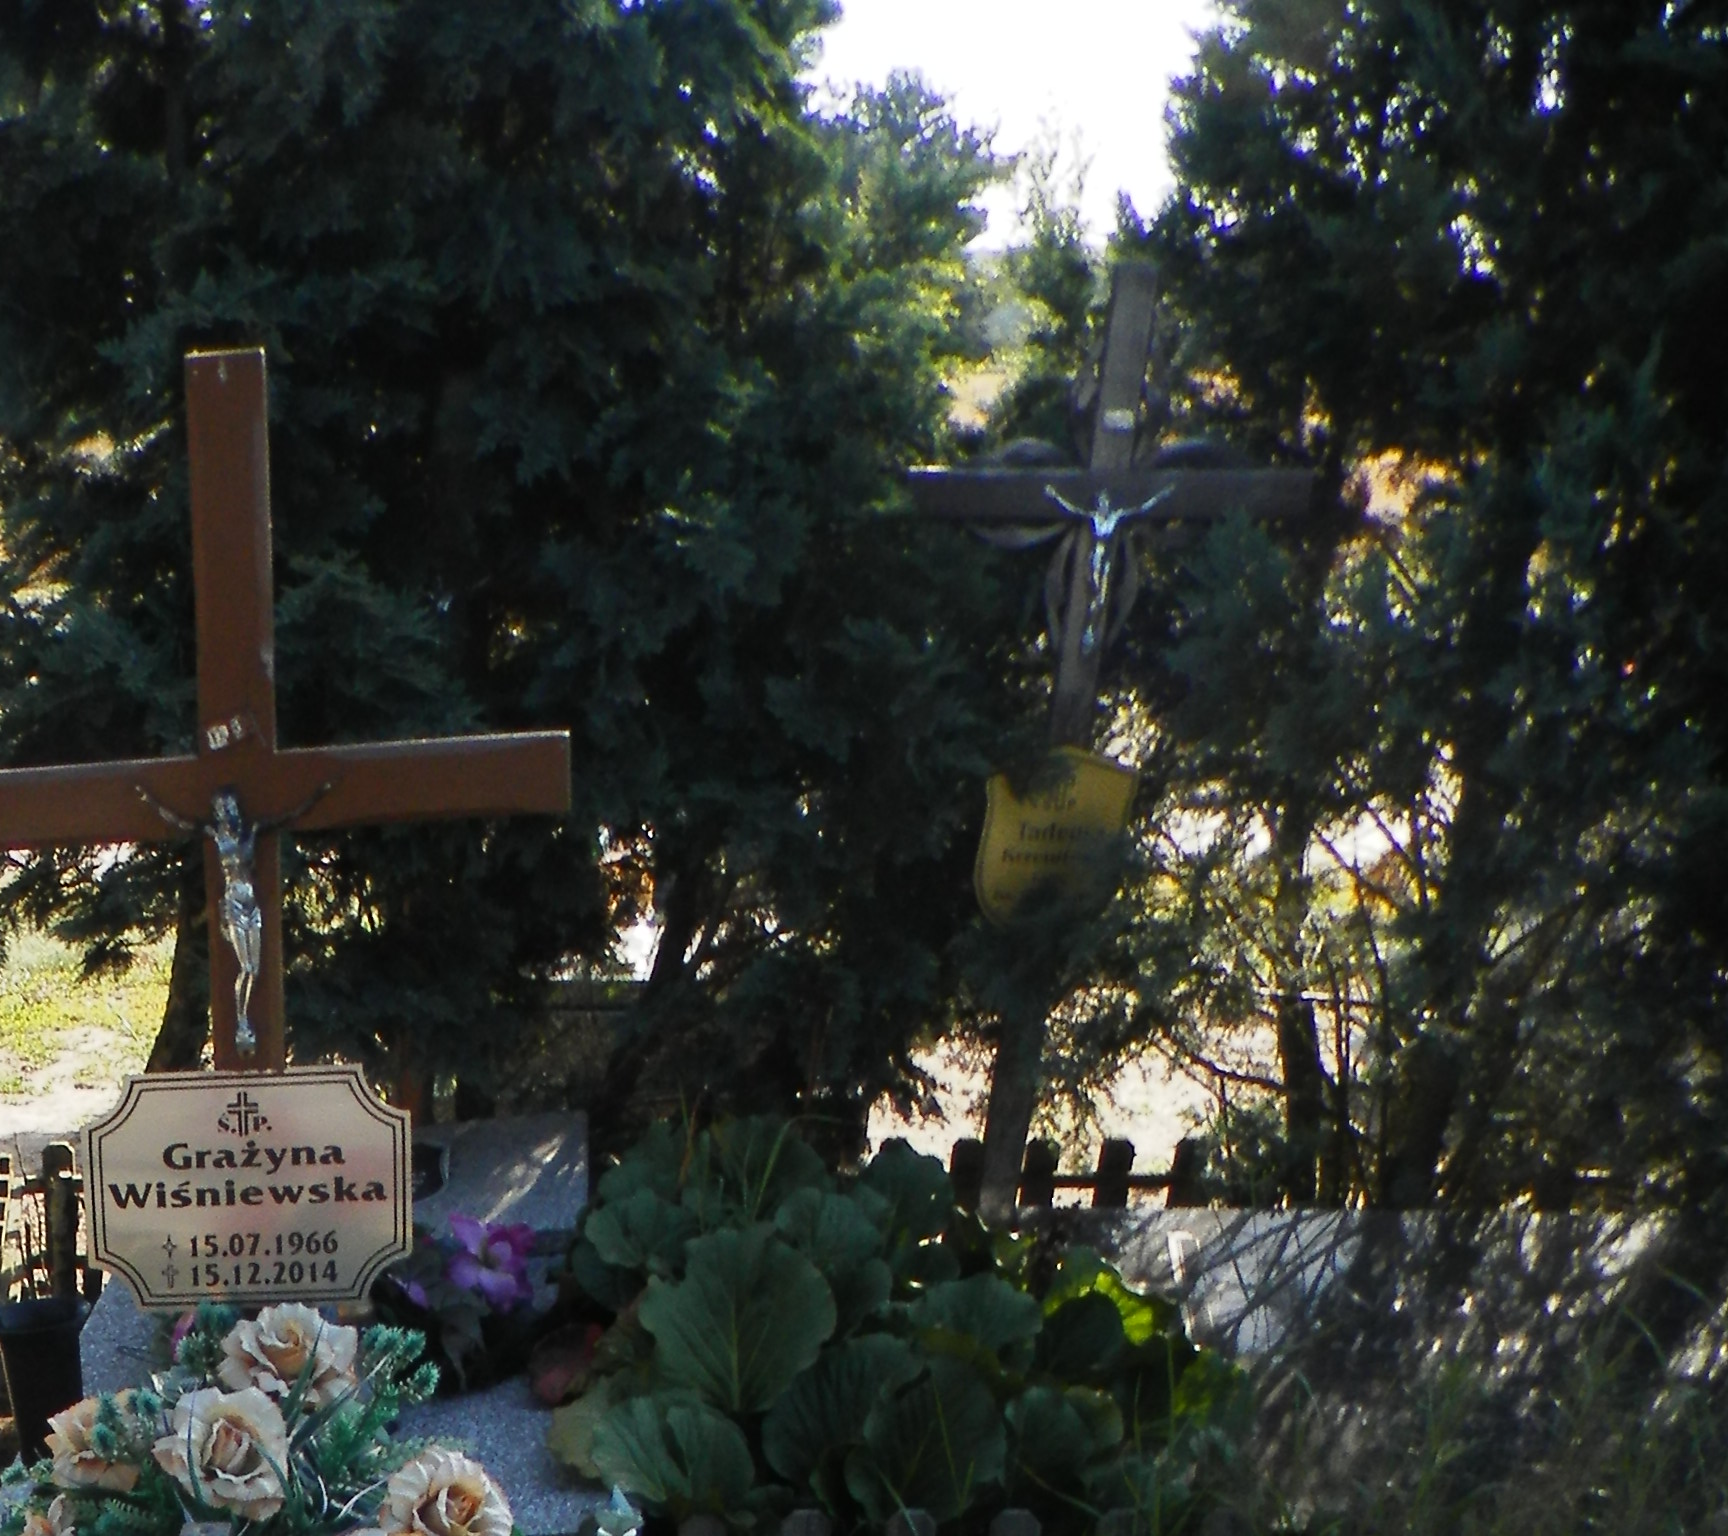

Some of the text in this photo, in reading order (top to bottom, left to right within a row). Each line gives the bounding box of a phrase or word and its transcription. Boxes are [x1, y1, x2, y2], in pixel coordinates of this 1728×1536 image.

[162, 1139, 346, 1175] Grażyna
[108, 1176, 388, 1210] Wiśniewska
[189, 1229, 339, 1259] 15.07.1966
[191, 1259, 339, 1287] 15.12.2014
